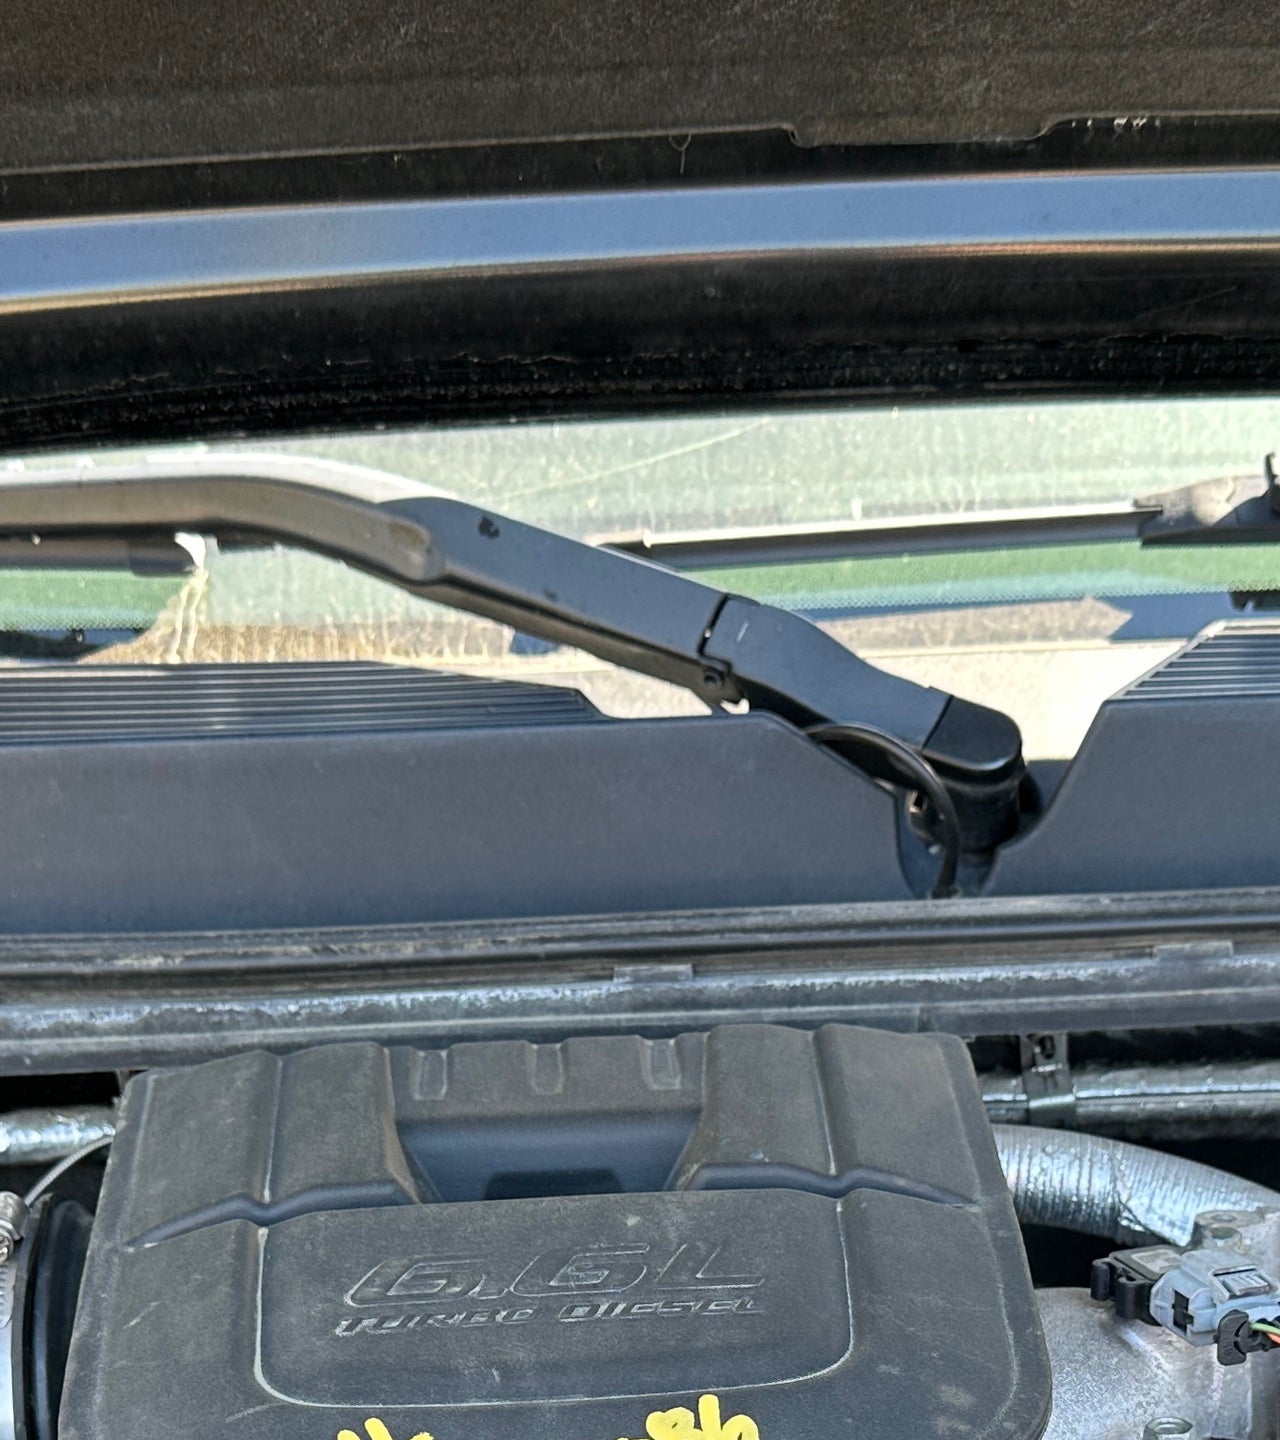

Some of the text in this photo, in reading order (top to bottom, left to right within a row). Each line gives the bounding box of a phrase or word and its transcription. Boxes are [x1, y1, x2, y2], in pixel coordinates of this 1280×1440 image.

[343, 1243, 766, 1308] 6.6L
[333, 1296, 766, 1338] TURBO DIESEL
